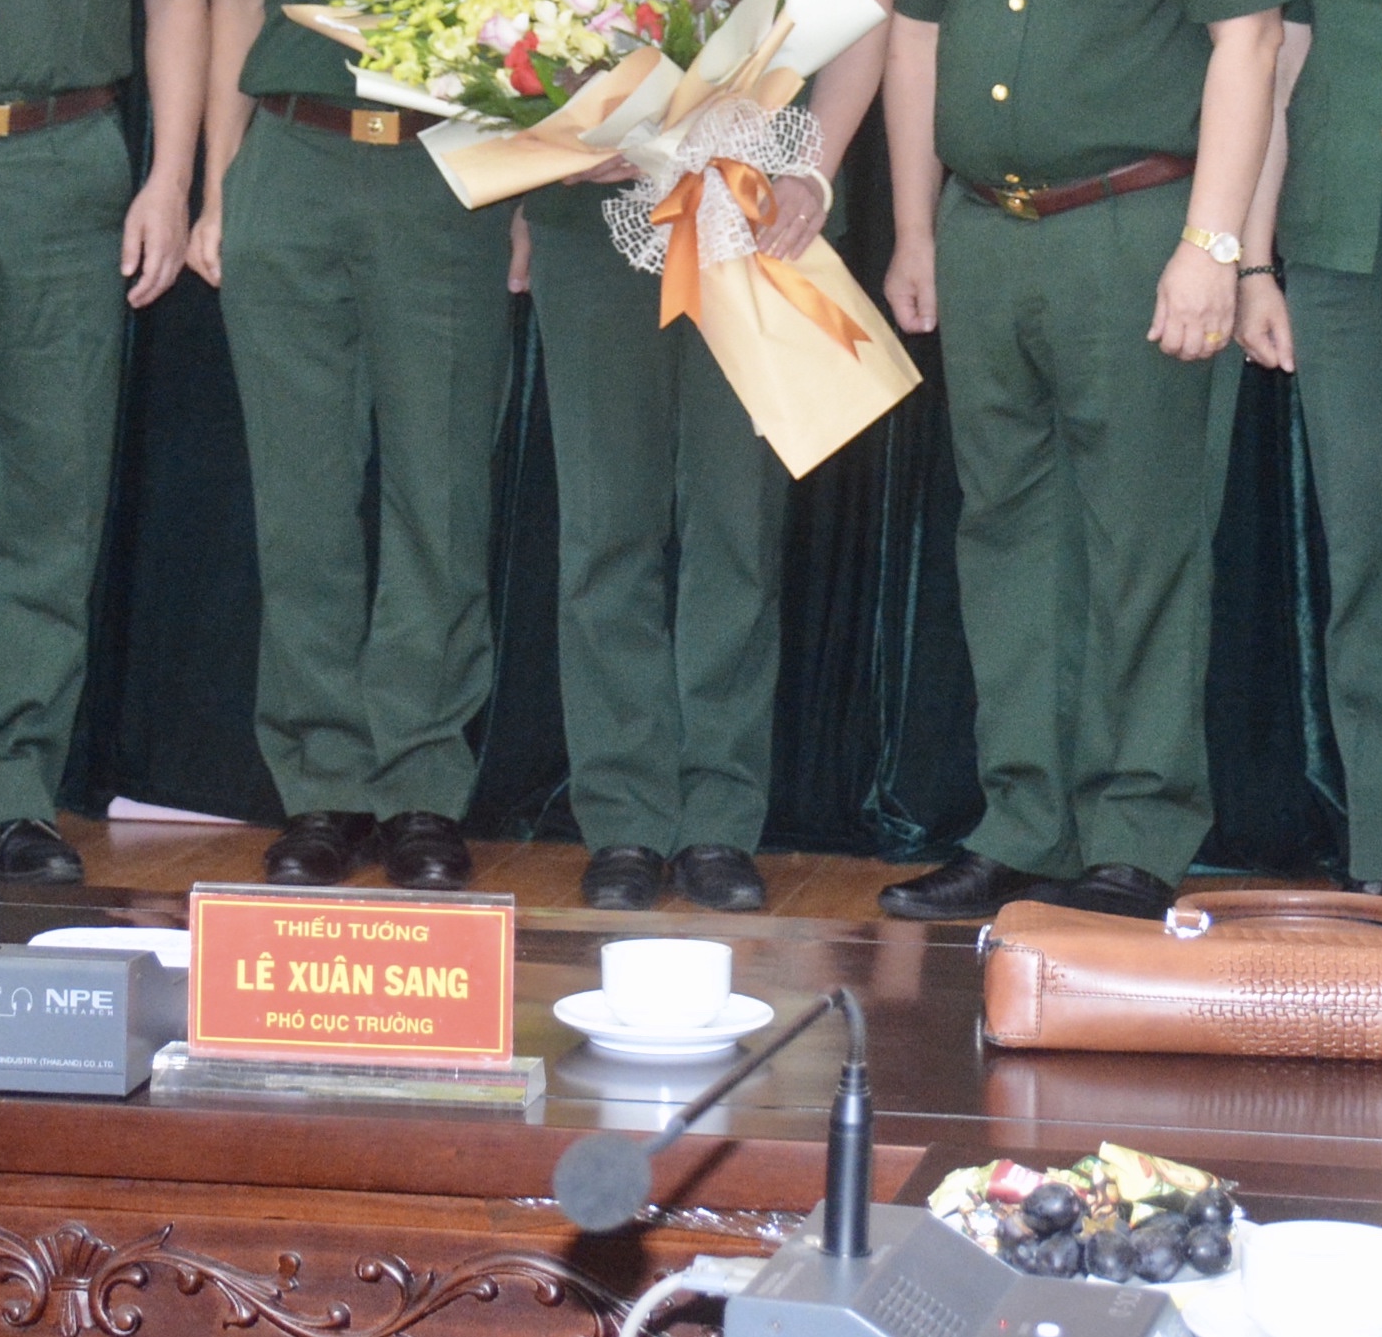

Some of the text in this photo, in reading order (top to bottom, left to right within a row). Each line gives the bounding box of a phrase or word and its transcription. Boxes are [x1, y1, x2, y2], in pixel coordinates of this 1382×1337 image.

[273, 915, 430, 943] THIẾU TƯỚNG
[236, 951, 468, 1000] LÊ XUÂN SANG
[45, 988, 114, 1009] NPE
[45, 1006, 114, 1016] RESEARCH
[265, 1009, 434, 1035] PHÓ CỤC TRƯỞNG
[0, 1056, 37, 1065] INDUSTRY
[39, 1057, 82, 1067] (THAILAND)
